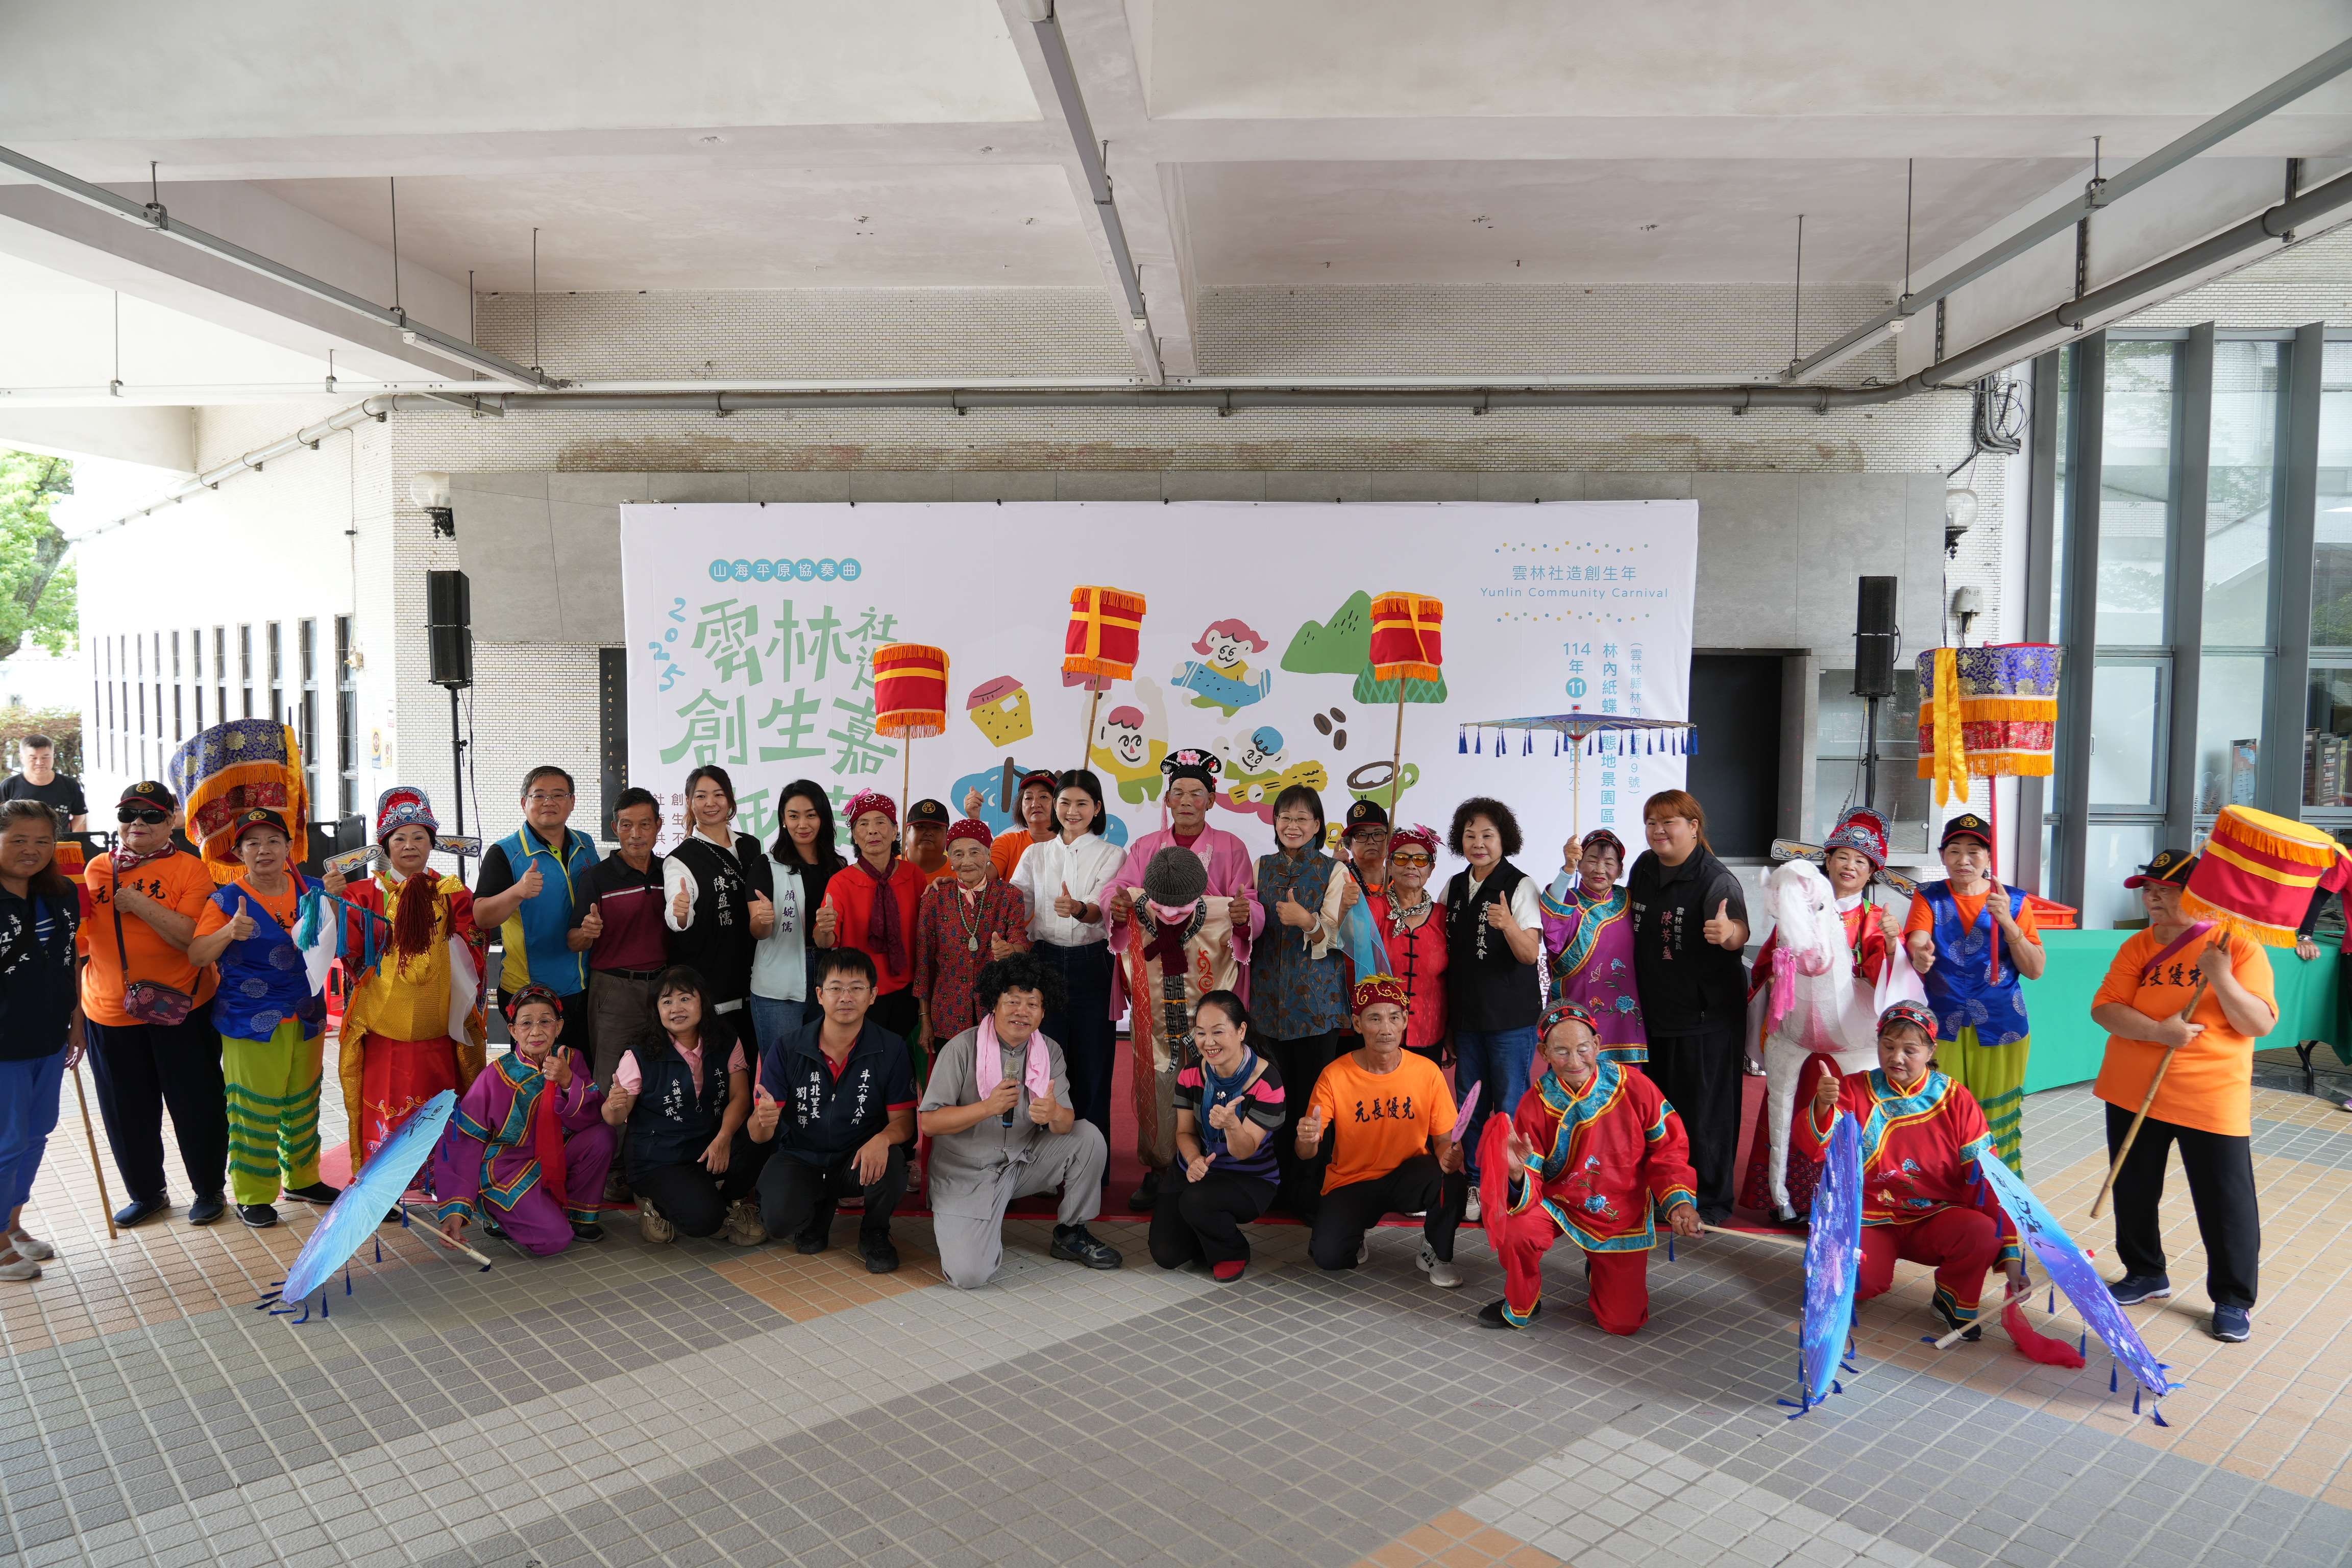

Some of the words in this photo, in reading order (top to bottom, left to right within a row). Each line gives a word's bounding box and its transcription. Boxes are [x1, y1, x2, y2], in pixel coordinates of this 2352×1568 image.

[714, 564, 856, 577] 山海平原協奏曲
[1512, 566, 1636, 581] 雲林社造創生年
[1480, 587, 1522, 597] Yunlin
[1529, 587, 1605, 600] Community
[1612, 588, 1668, 598] Carnival
[648, 597, 686, 692] 2025
[691, 598, 852, 687] 雲林
[1476, 900, 1491, 960] 雲林縣議會
[2140, 963, 2201, 987] 長優先
[810, 1071, 821, 1118] 鎮北里長
[1355, 1096, 1414, 1122] 元長優先
